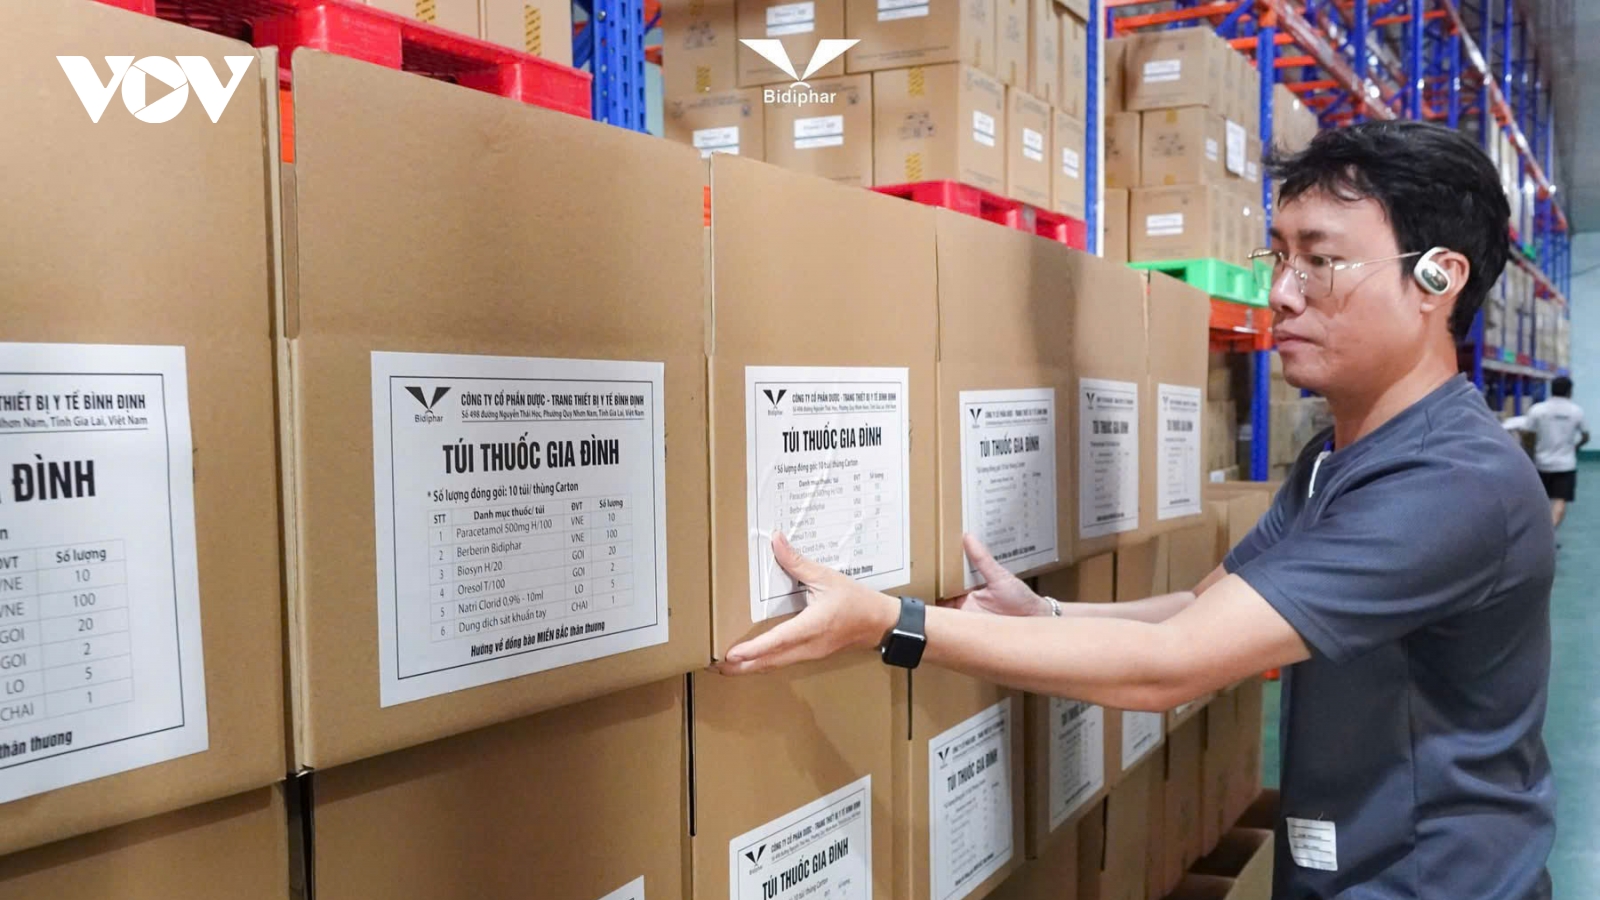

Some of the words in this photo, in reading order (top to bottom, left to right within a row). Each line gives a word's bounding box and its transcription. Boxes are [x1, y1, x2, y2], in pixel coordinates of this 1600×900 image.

[36, 394, 50, 414] BỊ
[53, 394, 61, 410] Y
[65, 389, 80, 410] TẾ
[84, 391, 114, 410] BÌNH
[117, 394, 146, 413] ĐỊNH
[461, 391, 482, 406] CÔNG
[484, 394, 492, 406] TY
[494, 389, 505, 406] CỔ
[506, 390, 526, 406] PHẦN
[527, 392, 545, 408] DƯỢC
[551, 394, 573, 406] TRANG
[574, 391, 591, 406] THIẾT
[592, 394, 599, 408] BỊ
[600, 394, 605, 406] Y
[605, 391, 613, 406] TẾ
[614, 392, 629, 406] BÌNH
[630, 394, 644, 408] ĐỊNH
[73, 415, 89, 427] Gia
[91, 414, 107, 427] Lai,
[127, 413, 148, 426] Nam
[415, 414, 443, 424] Bidiphar
[470, 409, 480, 417] 498
[783, 427, 799, 453] TÚI
[803, 422, 837, 451] THUỐC
[840, 427, 856, 449] GIA
[859, 423, 882, 447] ĐÌNH
[443, 438, 474, 474] TÚI
[480, 432, 541, 473] THUỐC
[547, 440, 575, 469] GIA
[580, 434, 619, 466] ĐÌNH
[12, 453, 96, 502] ĐÌNH
[433, 487, 444, 502] Số
[445, 489, 469, 503] lượng
[470, 487, 491, 501] đóng
[492, 486, 508, 501] gói:
[509, 485, 517, 496] 10
[533, 482, 554, 496] thùng
[555, 481, 579, 492] Carton
[433, 513, 446, 524] STT
[473, 509, 493, 520] Danh
[495, 510, 510, 520] mục
[511, 506, 534, 518] thuốc/
[535, 505, 545, 515] túi
[571, 501, 583, 511] ĐVT
[599, 498, 606, 508] Số
[607, 498, 623, 509] lượng
[456, 522, 503, 538] Paracetamol
[504, 522, 530, 533] 500mg
[531, 518, 553, 530] H/100
[571, 515, 584, 526] VNE
[608, 513, 616, 522] 10
[56, 549, 72, 563] Số
[73, 548, 107, 562] lượng
[439, 550, 444, 560] 2
[457, 544, 490, 557] Berberin
[491, 541, 522, 554] Bidiphar
[571, 532, 585, 543] VNE
[606, 529, 618, 539] 100
[75, 569, 90, 582] 10
[439, 569, 444, 580] 3
[457, 564, 483, 577] Biosyn
[484, 560, 503, 572] H/20
[572, 550, 584, 560] GOI
[608, 546, 616, 555] 20
[440, 588, 444, 598] 4
[457, 582, 483, 595] Oresol
[484, 578, 506, 590] T/100
[572, 567, 585, 577] GOI
[610, 562, 615, 571] 2
[73, 593, 96, 607] 100
[440, 607, 445, 617] 5
[458, 601, 477, 614] Natri
[478, 599, 501, 610] Clorid
[526, 590, 544, 602] 10ml
[574, 584, 584, 594] LO
[611, 579, 615, 588] 5
[78, 618, 94, 631] 20
[440, 626, 446, 636] 6
[458, 621, 480, 633] Dung
[482, 616, 499, 629] dịch
[500, 614, 511, 625] sát
[536, 609, 547, 619] tay
[571, 600, 588, 611] CHAI
[537, 627, 555, 643] MIỀN
[555, 624, 569, 640] BẮC
[1, 653, 26, 669] GOI
[83, 643, 91, 655] 2
[6, 680, 25, 694] LO
[85, 667, 92, 680] 5
[1, 703, 34, 721] CHAI
[87, 691, 93, 703] 1
[762, 874, 777, 900] TÚI
[780, 854, 810, 892] THUỐC
[813, 850, 827, 874] GIA
[829, 837, 849, 865] ĐÌNH
